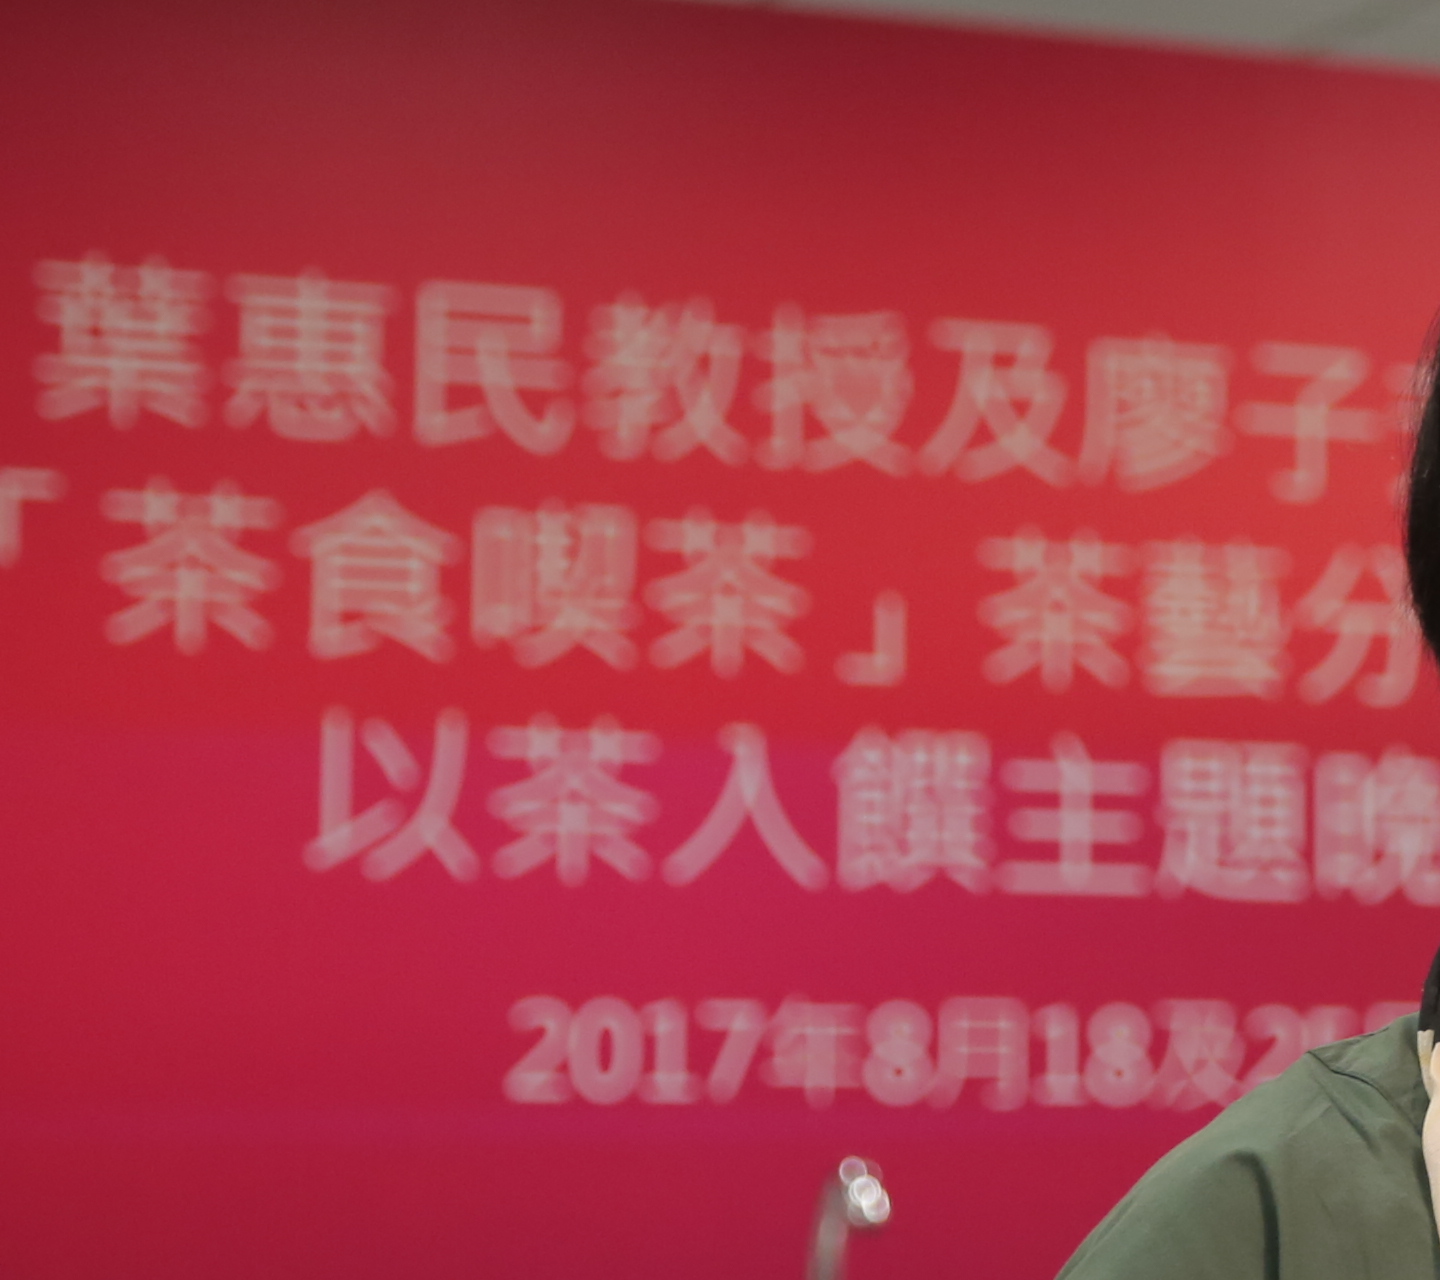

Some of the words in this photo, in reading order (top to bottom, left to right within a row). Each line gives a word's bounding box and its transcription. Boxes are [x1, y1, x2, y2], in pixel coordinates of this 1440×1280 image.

[33, 250, 1432, 504] 葉惠民教授及廖子
